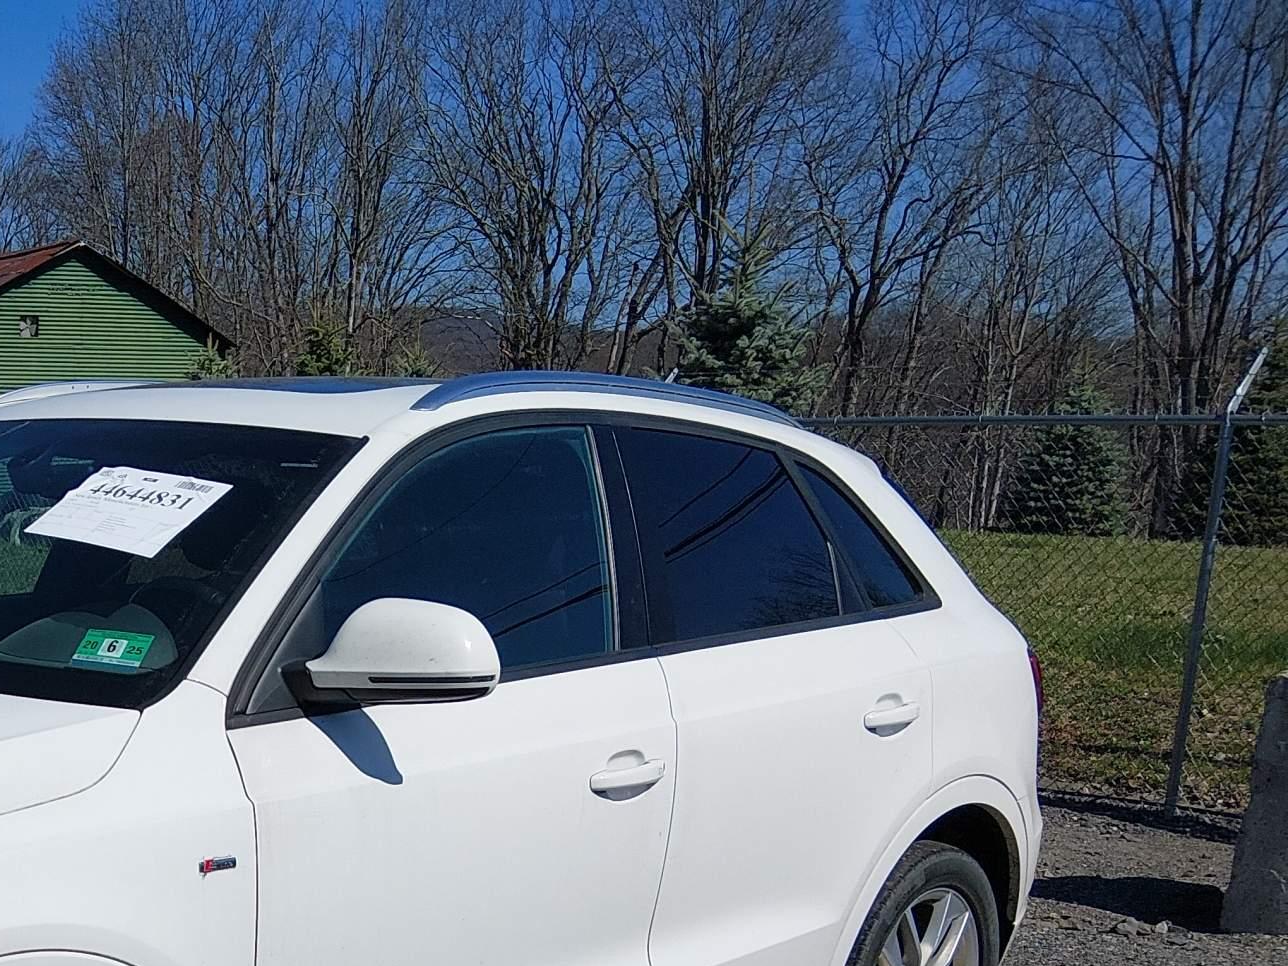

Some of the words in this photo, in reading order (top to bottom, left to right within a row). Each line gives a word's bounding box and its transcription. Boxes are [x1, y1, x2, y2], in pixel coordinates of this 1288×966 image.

[89, 482, 194, 510] 44644831
[82, 640, 99, 650] 20
[106, 639, 120, 653] 6
[126, 645, 145, 656] 25
